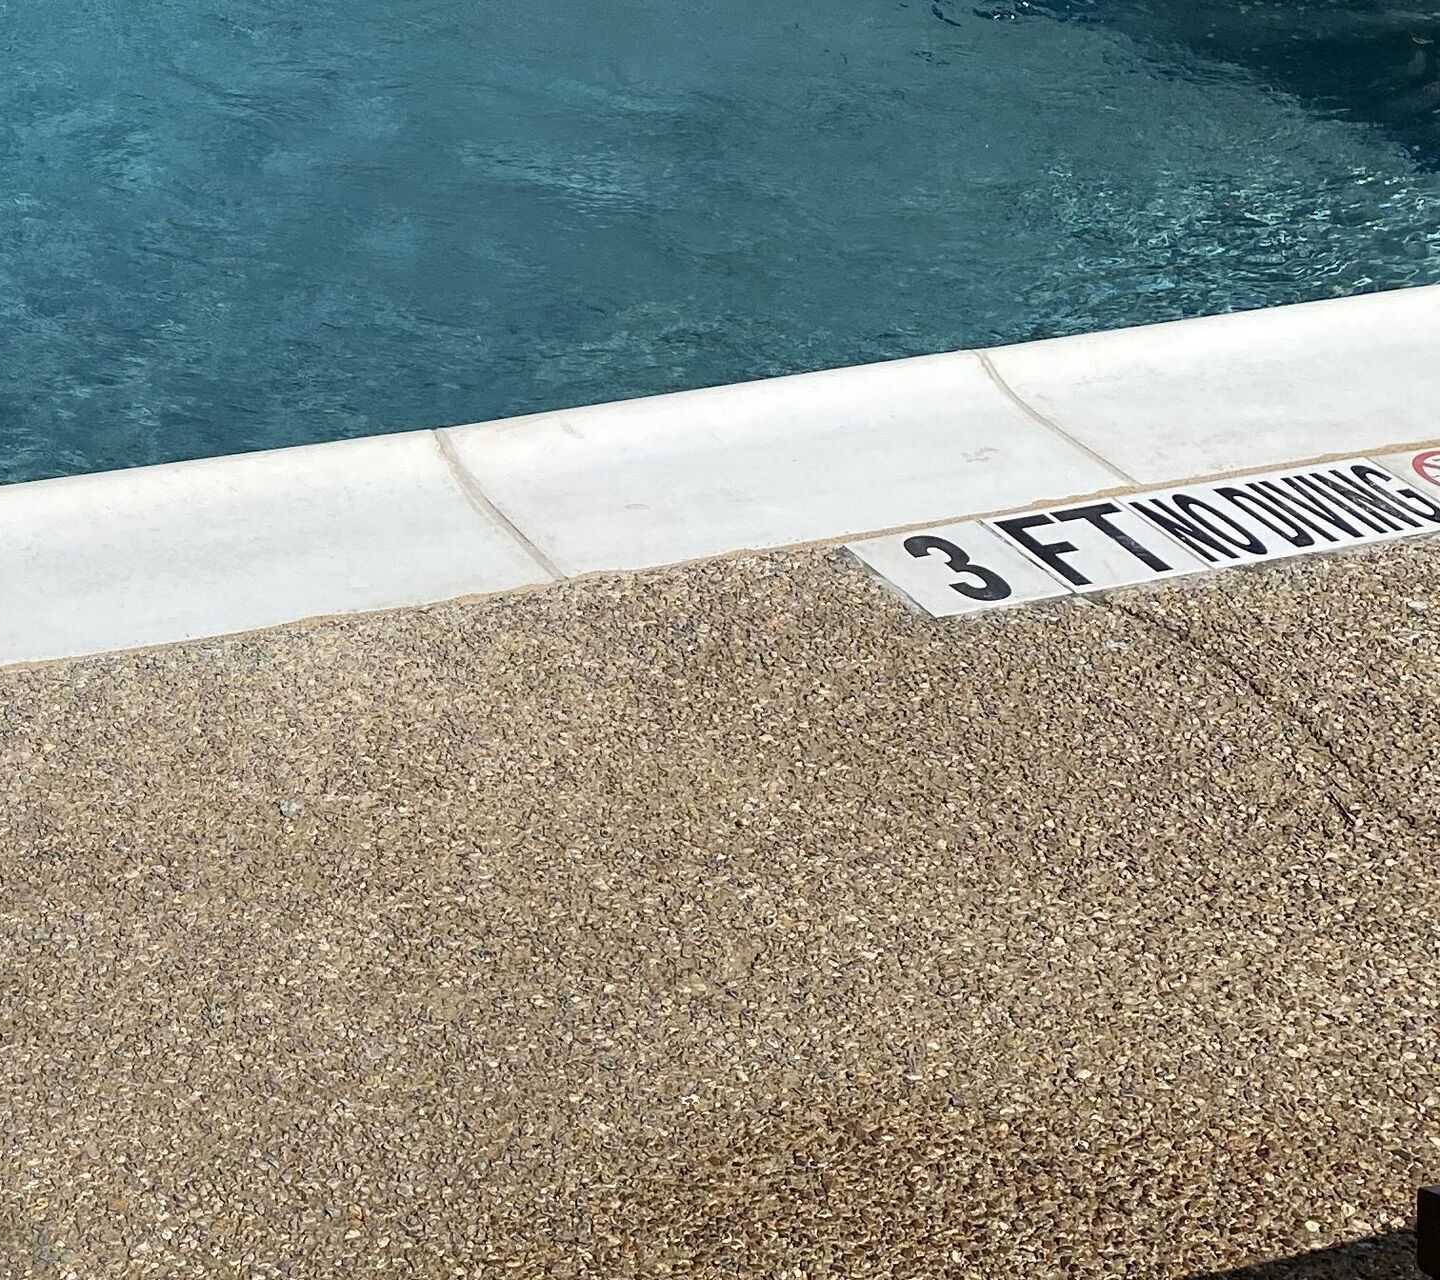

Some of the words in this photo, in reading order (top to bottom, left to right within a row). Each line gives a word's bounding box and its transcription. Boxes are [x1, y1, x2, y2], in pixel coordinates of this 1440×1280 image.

[903, 534, 1012, 602] 3
[994, 502, 1173, 587] FT
[1128, 492, 1268, 563] NO
[1212, 464, 1440, 548] DIVING
